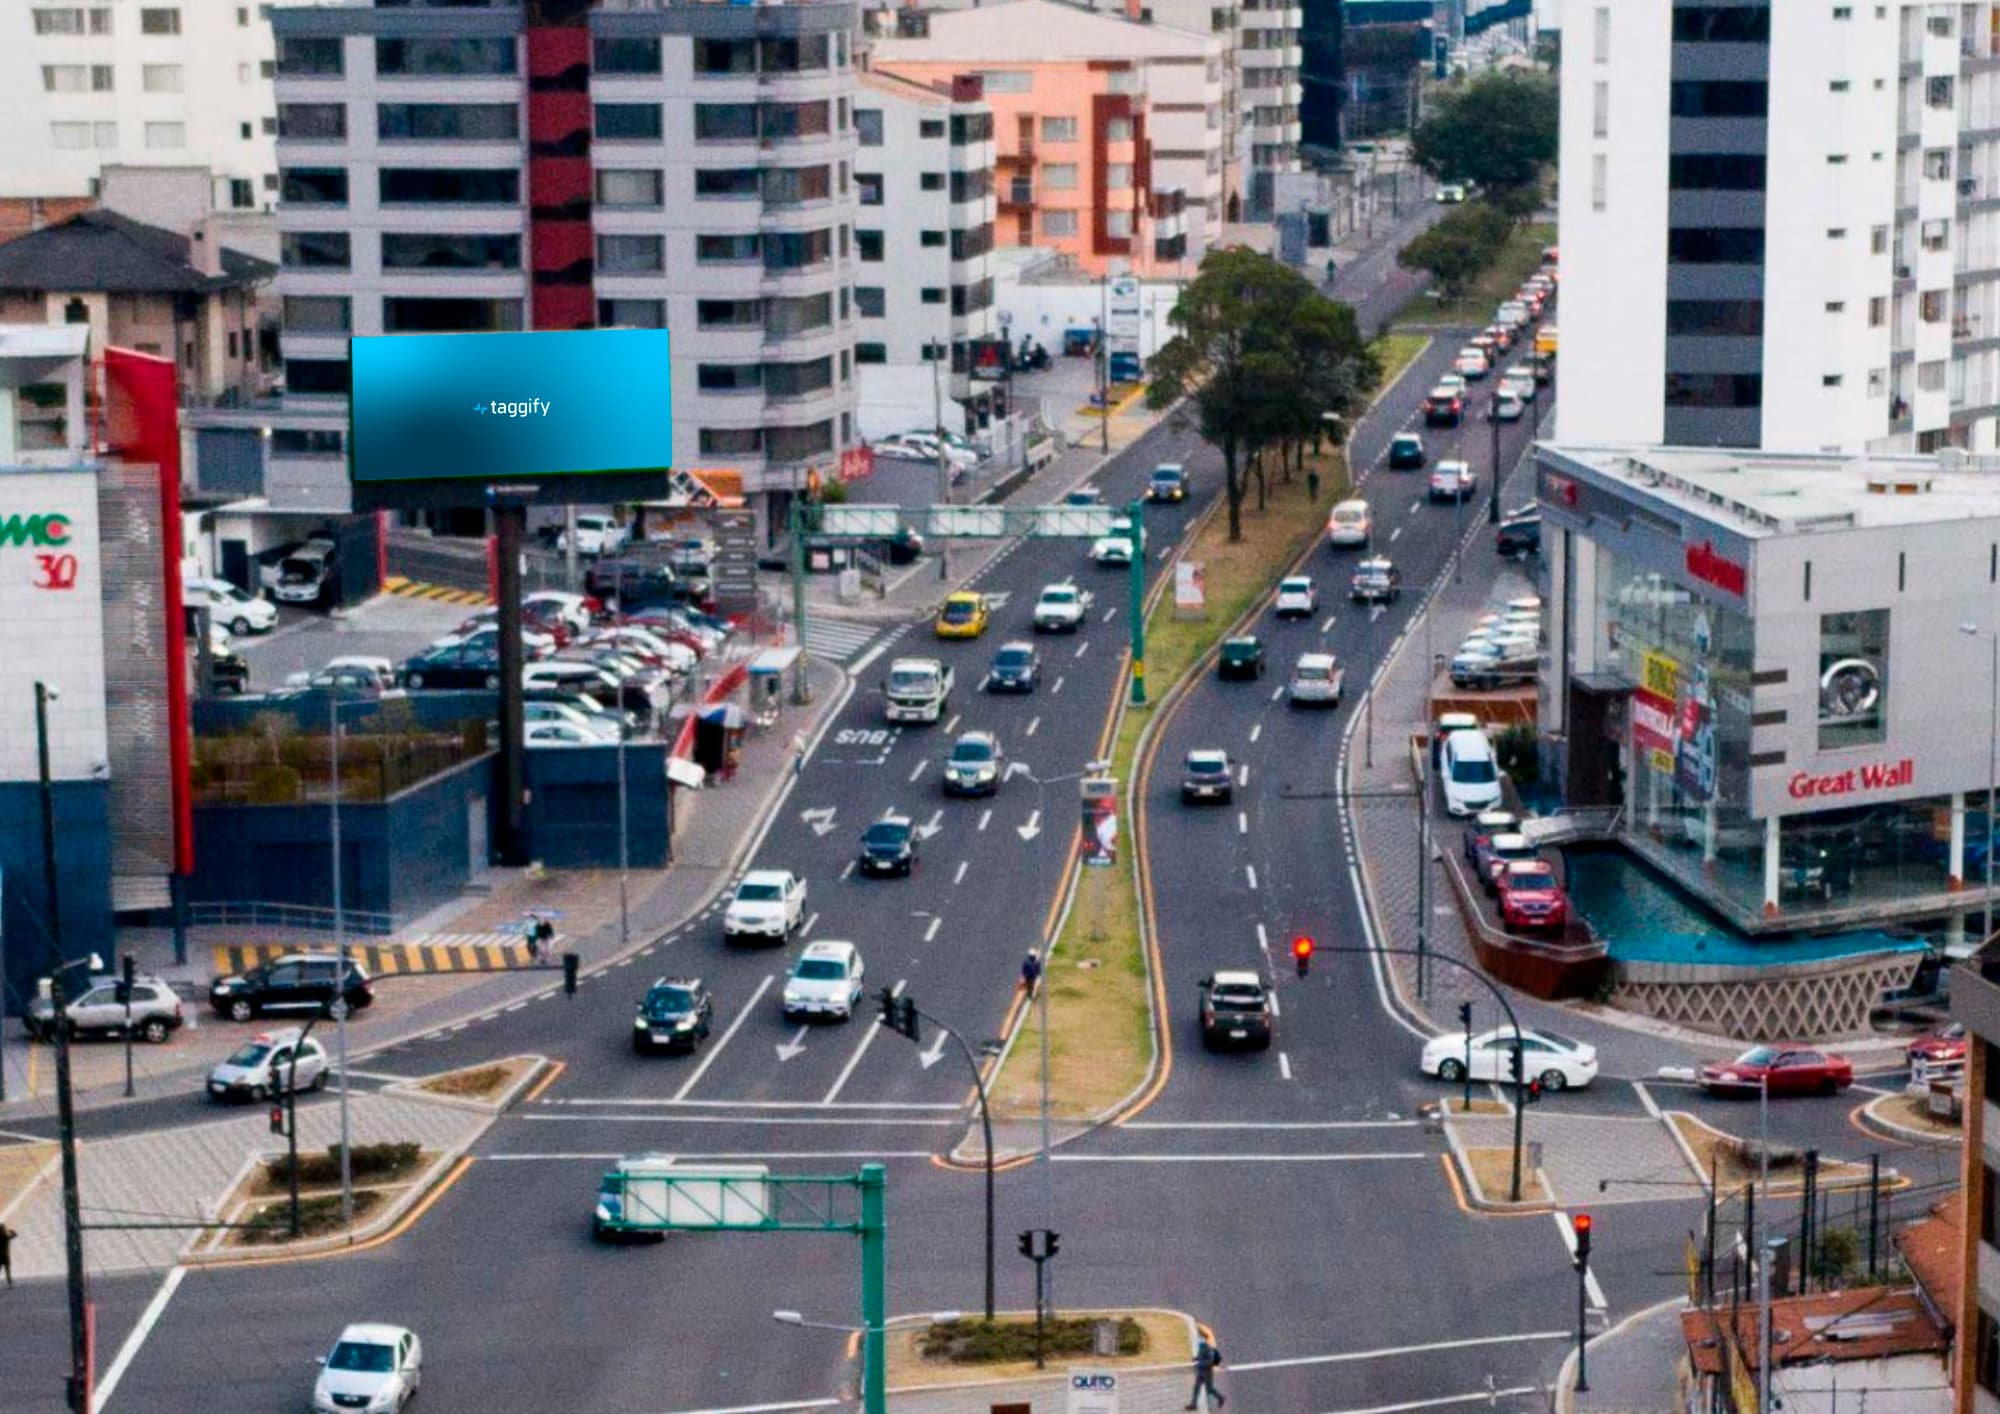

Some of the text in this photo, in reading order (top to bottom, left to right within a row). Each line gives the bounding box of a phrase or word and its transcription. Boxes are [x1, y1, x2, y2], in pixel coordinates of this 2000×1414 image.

[490, 398, 551, 418] taggify
[34, 553, 77, 590] 30
[835, 729, 889, 745] BUS
[1788, 759, 1913, 799] Great Wall
[1071, 1374, 1116, 1389] QUITO
